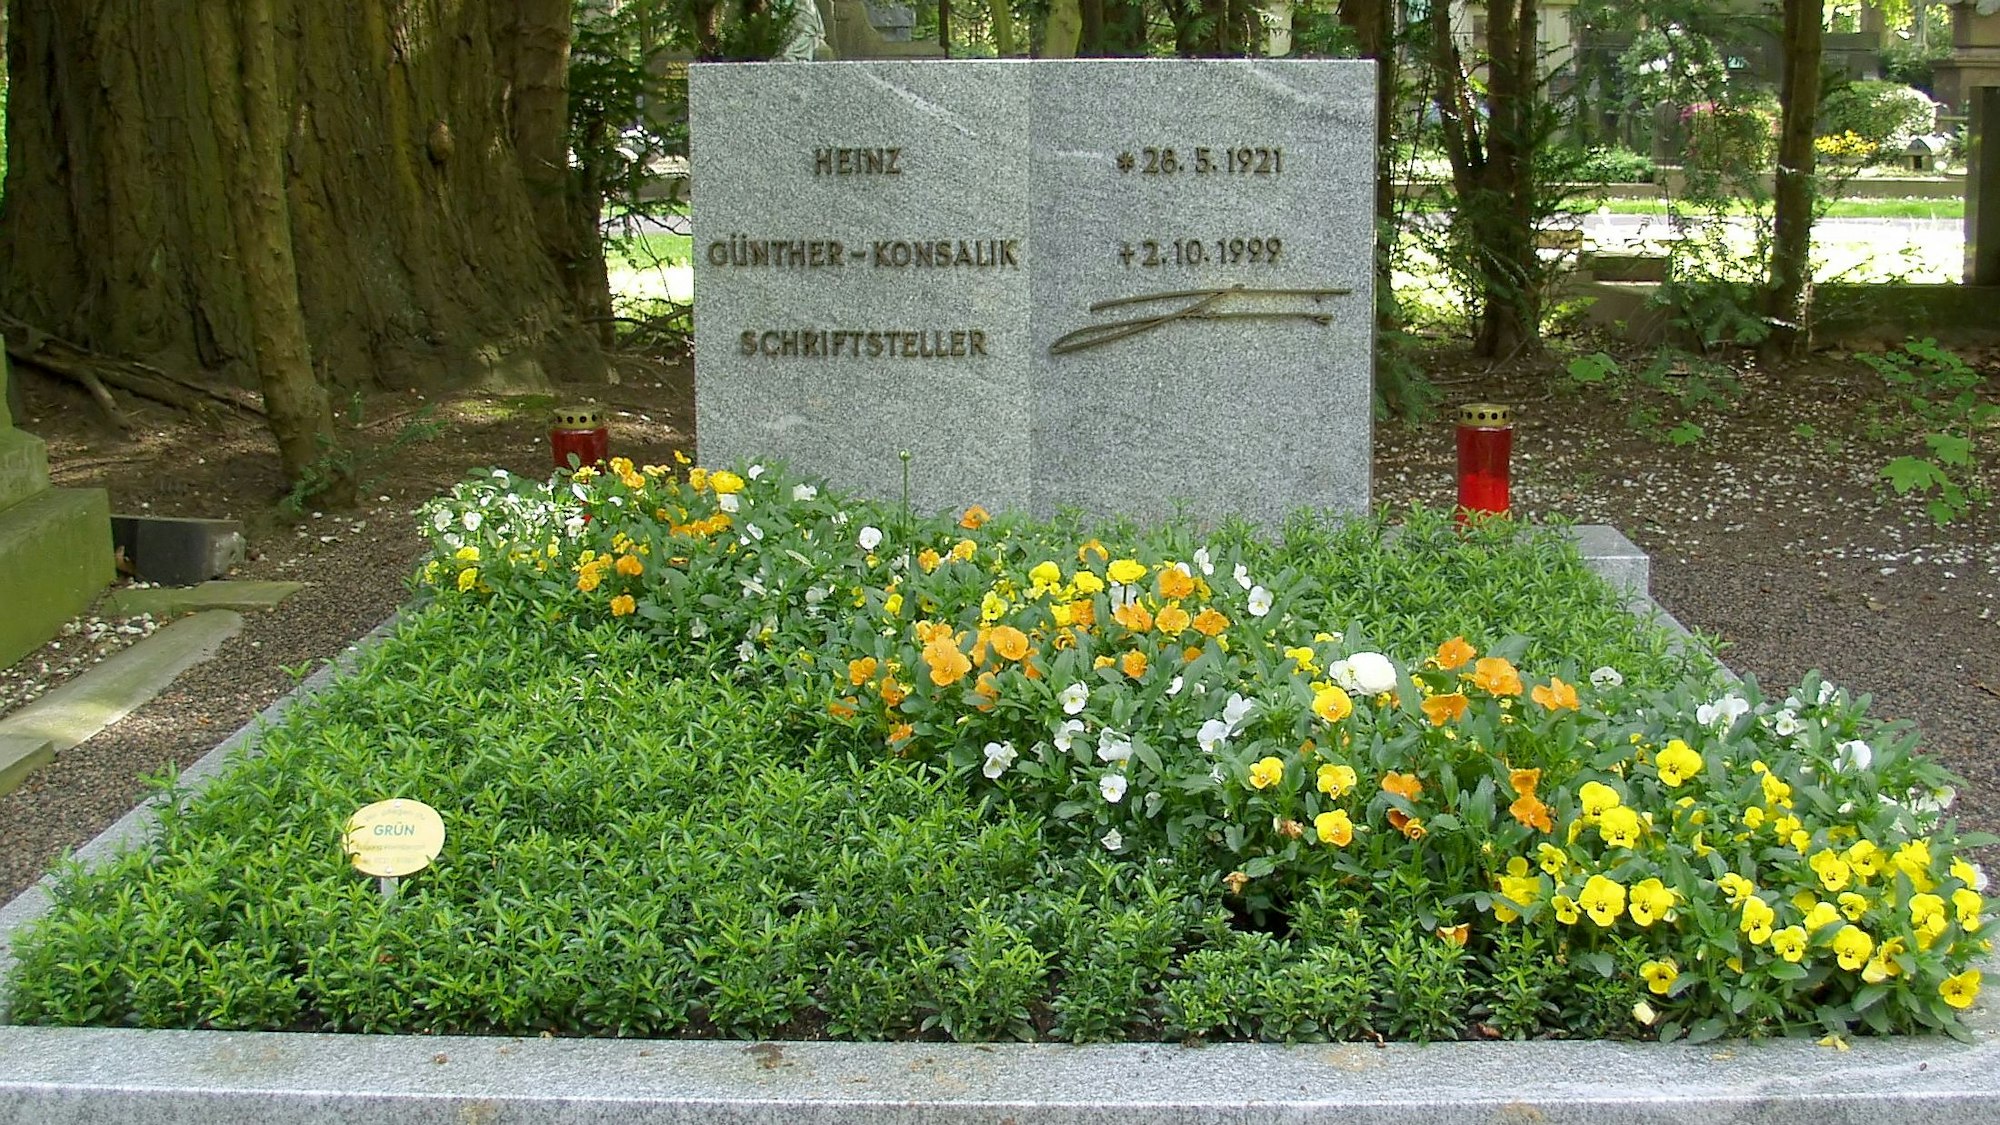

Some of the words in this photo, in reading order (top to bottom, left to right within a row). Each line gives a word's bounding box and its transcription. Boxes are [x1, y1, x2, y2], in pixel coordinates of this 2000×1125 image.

[814, 148, 901, 176] HEINZ
[707, 233, 844, 267] GÜNTHER
[872, 239, 1018, 269] KONSALIK
[740, 329, 988, 358] SCHRIFTSTELLER
[373, 821, 415, 836] GRÜN
